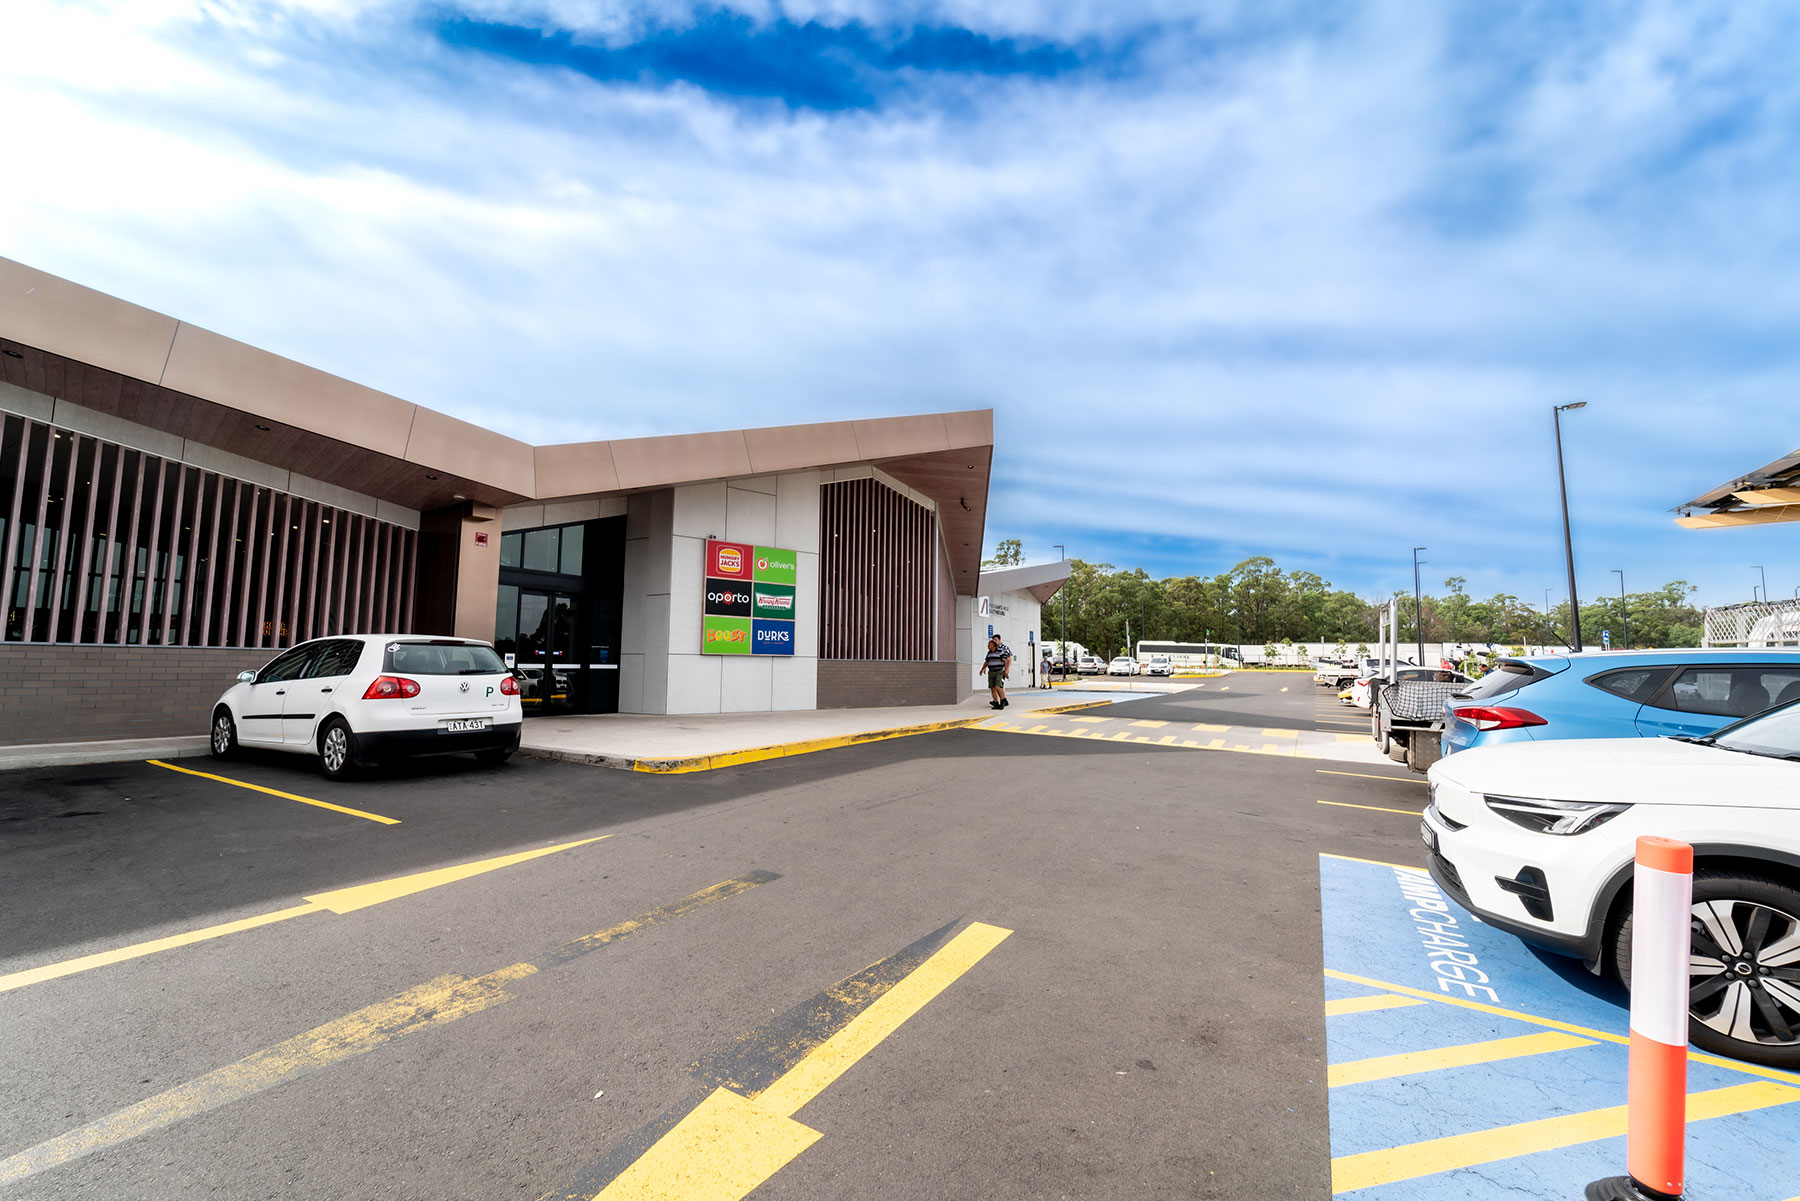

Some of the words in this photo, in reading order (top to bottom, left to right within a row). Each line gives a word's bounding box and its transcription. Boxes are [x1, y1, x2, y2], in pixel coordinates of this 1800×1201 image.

[769, 561, 795, 570] oliver's
[707, 592, 749, 603] oporto
[707, 629, 747, 642] BOOST
[486, 686, 494, 697] P
